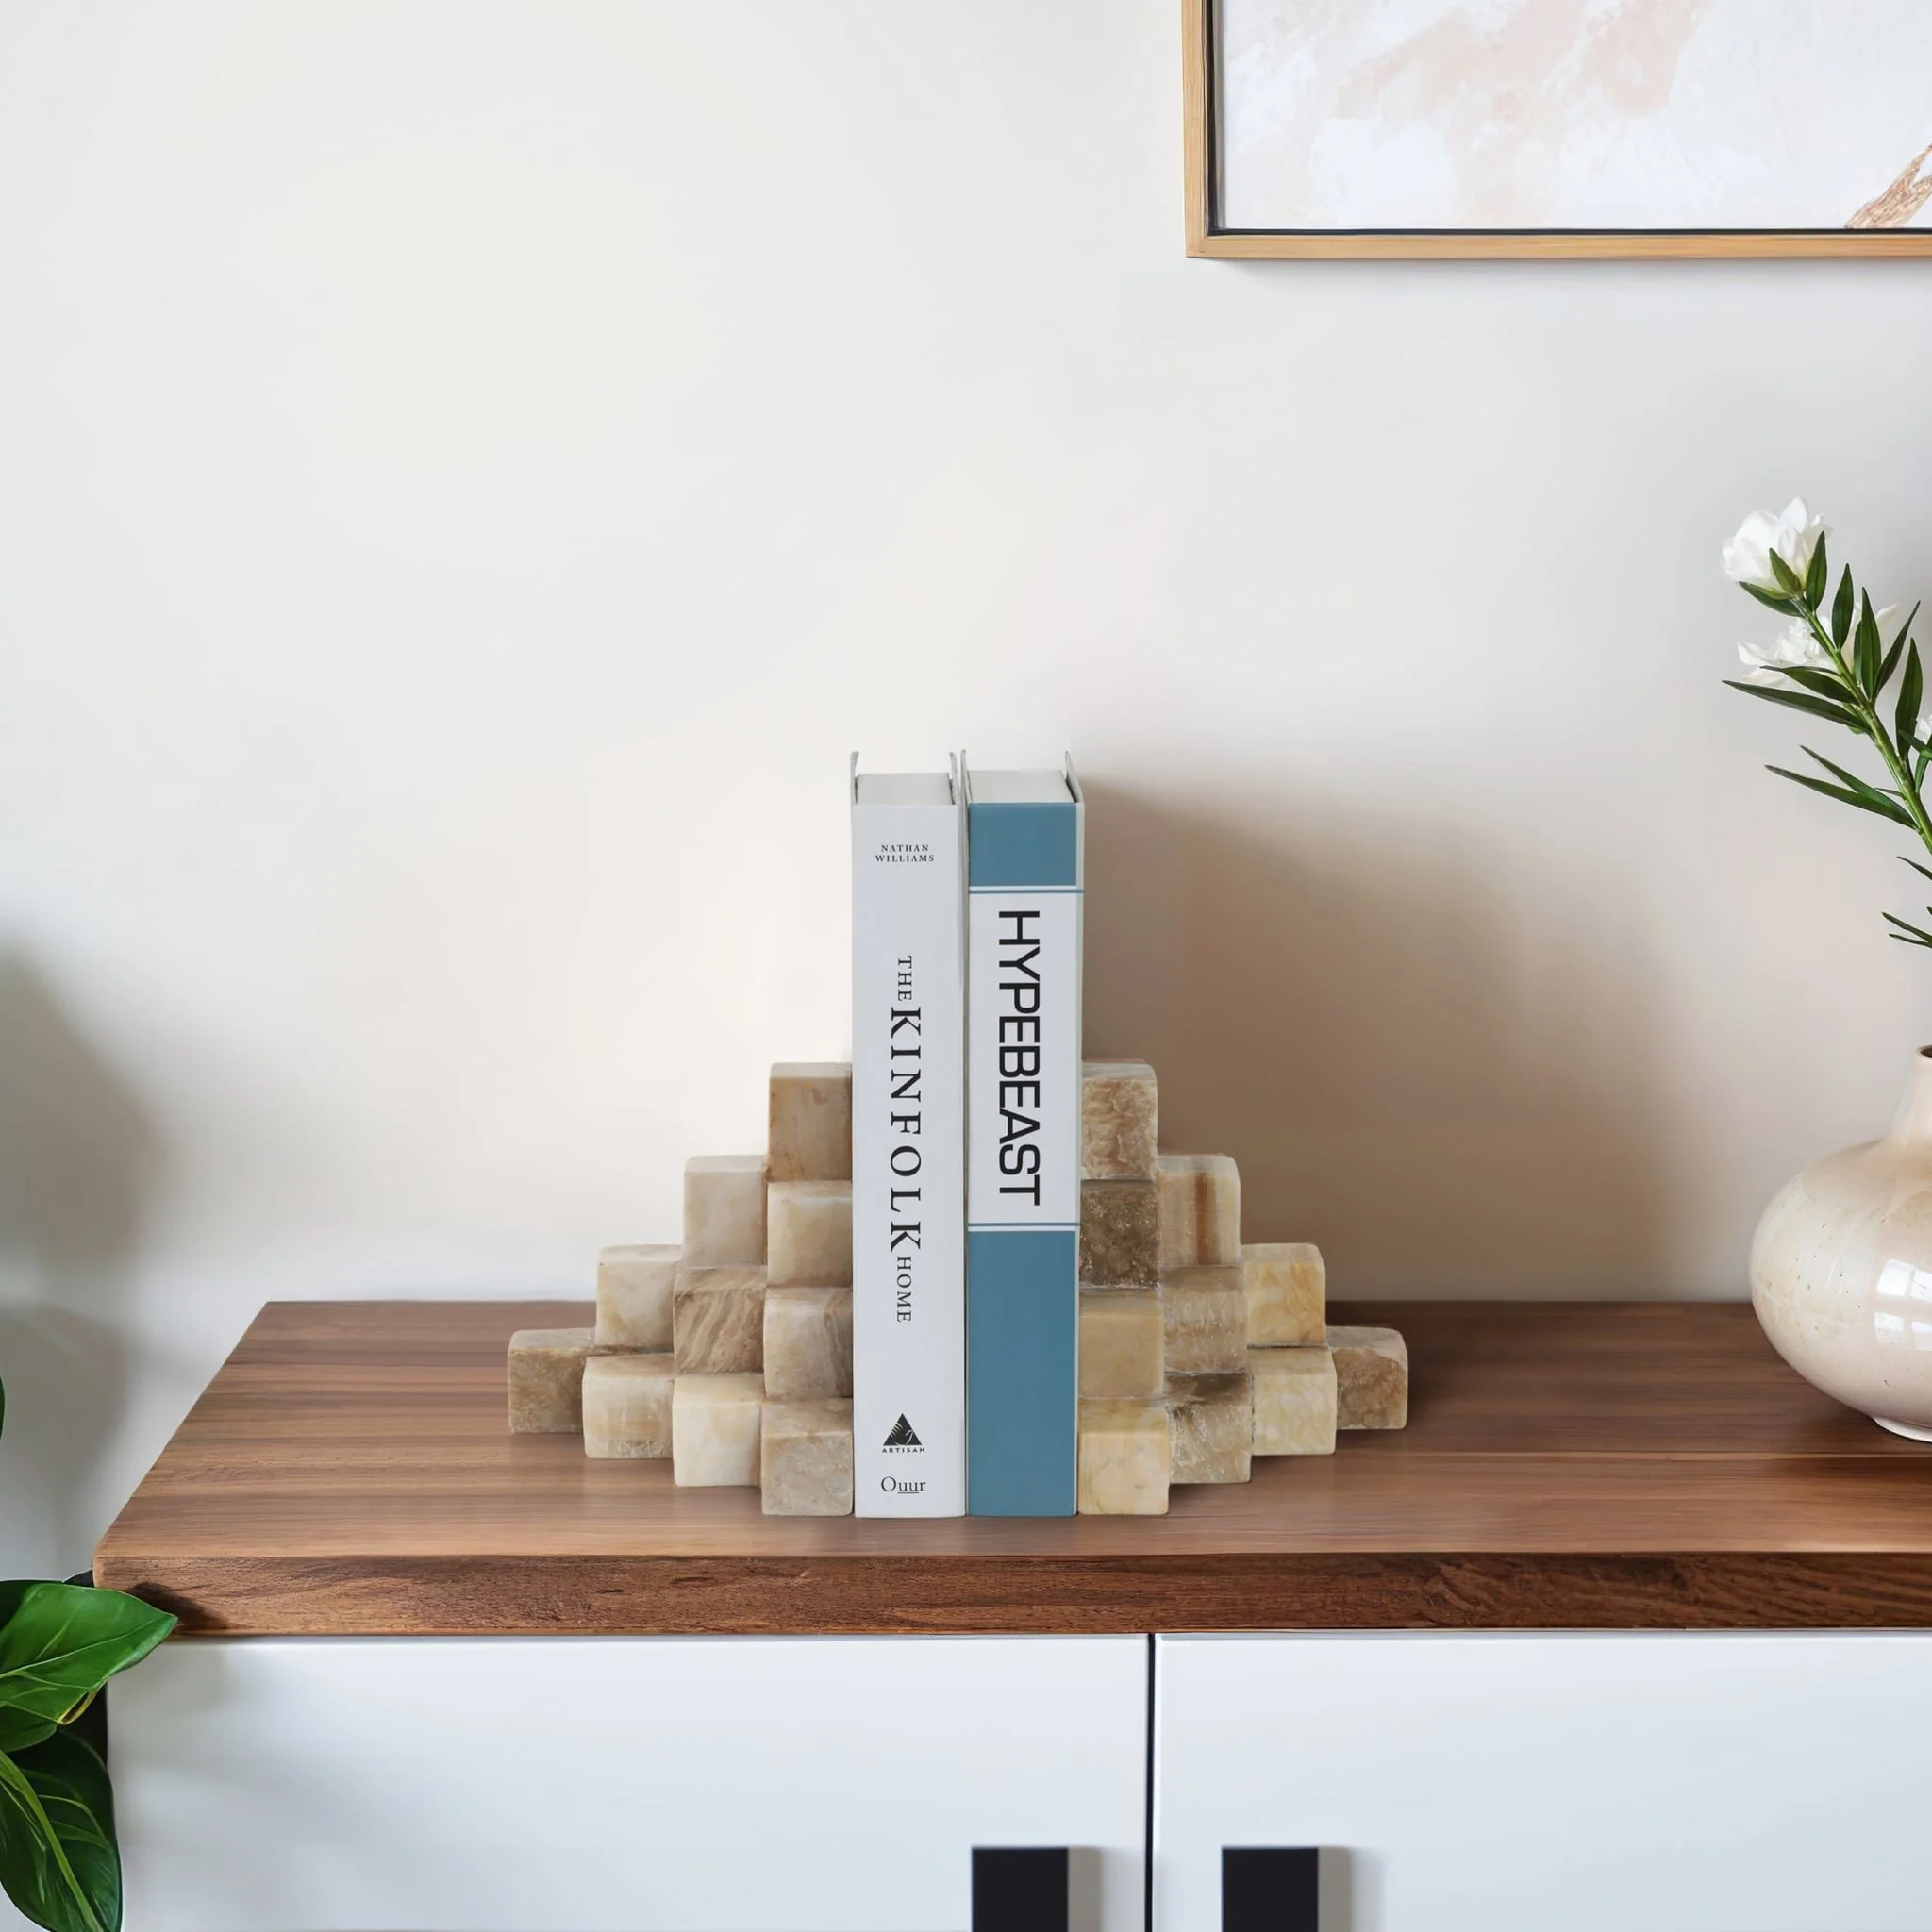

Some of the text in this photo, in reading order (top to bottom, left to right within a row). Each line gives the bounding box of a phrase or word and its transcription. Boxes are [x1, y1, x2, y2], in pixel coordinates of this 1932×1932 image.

[874, 854, 935, 862] WILLIAMS
[880, 844, 929, 853] NATHAN
[998, 910, 1041, 1207] HYPEBEAST
[890, 955, 922, 1323] THE KINFOLK HOME
[880, 1475, 926, 1494] Ouur
